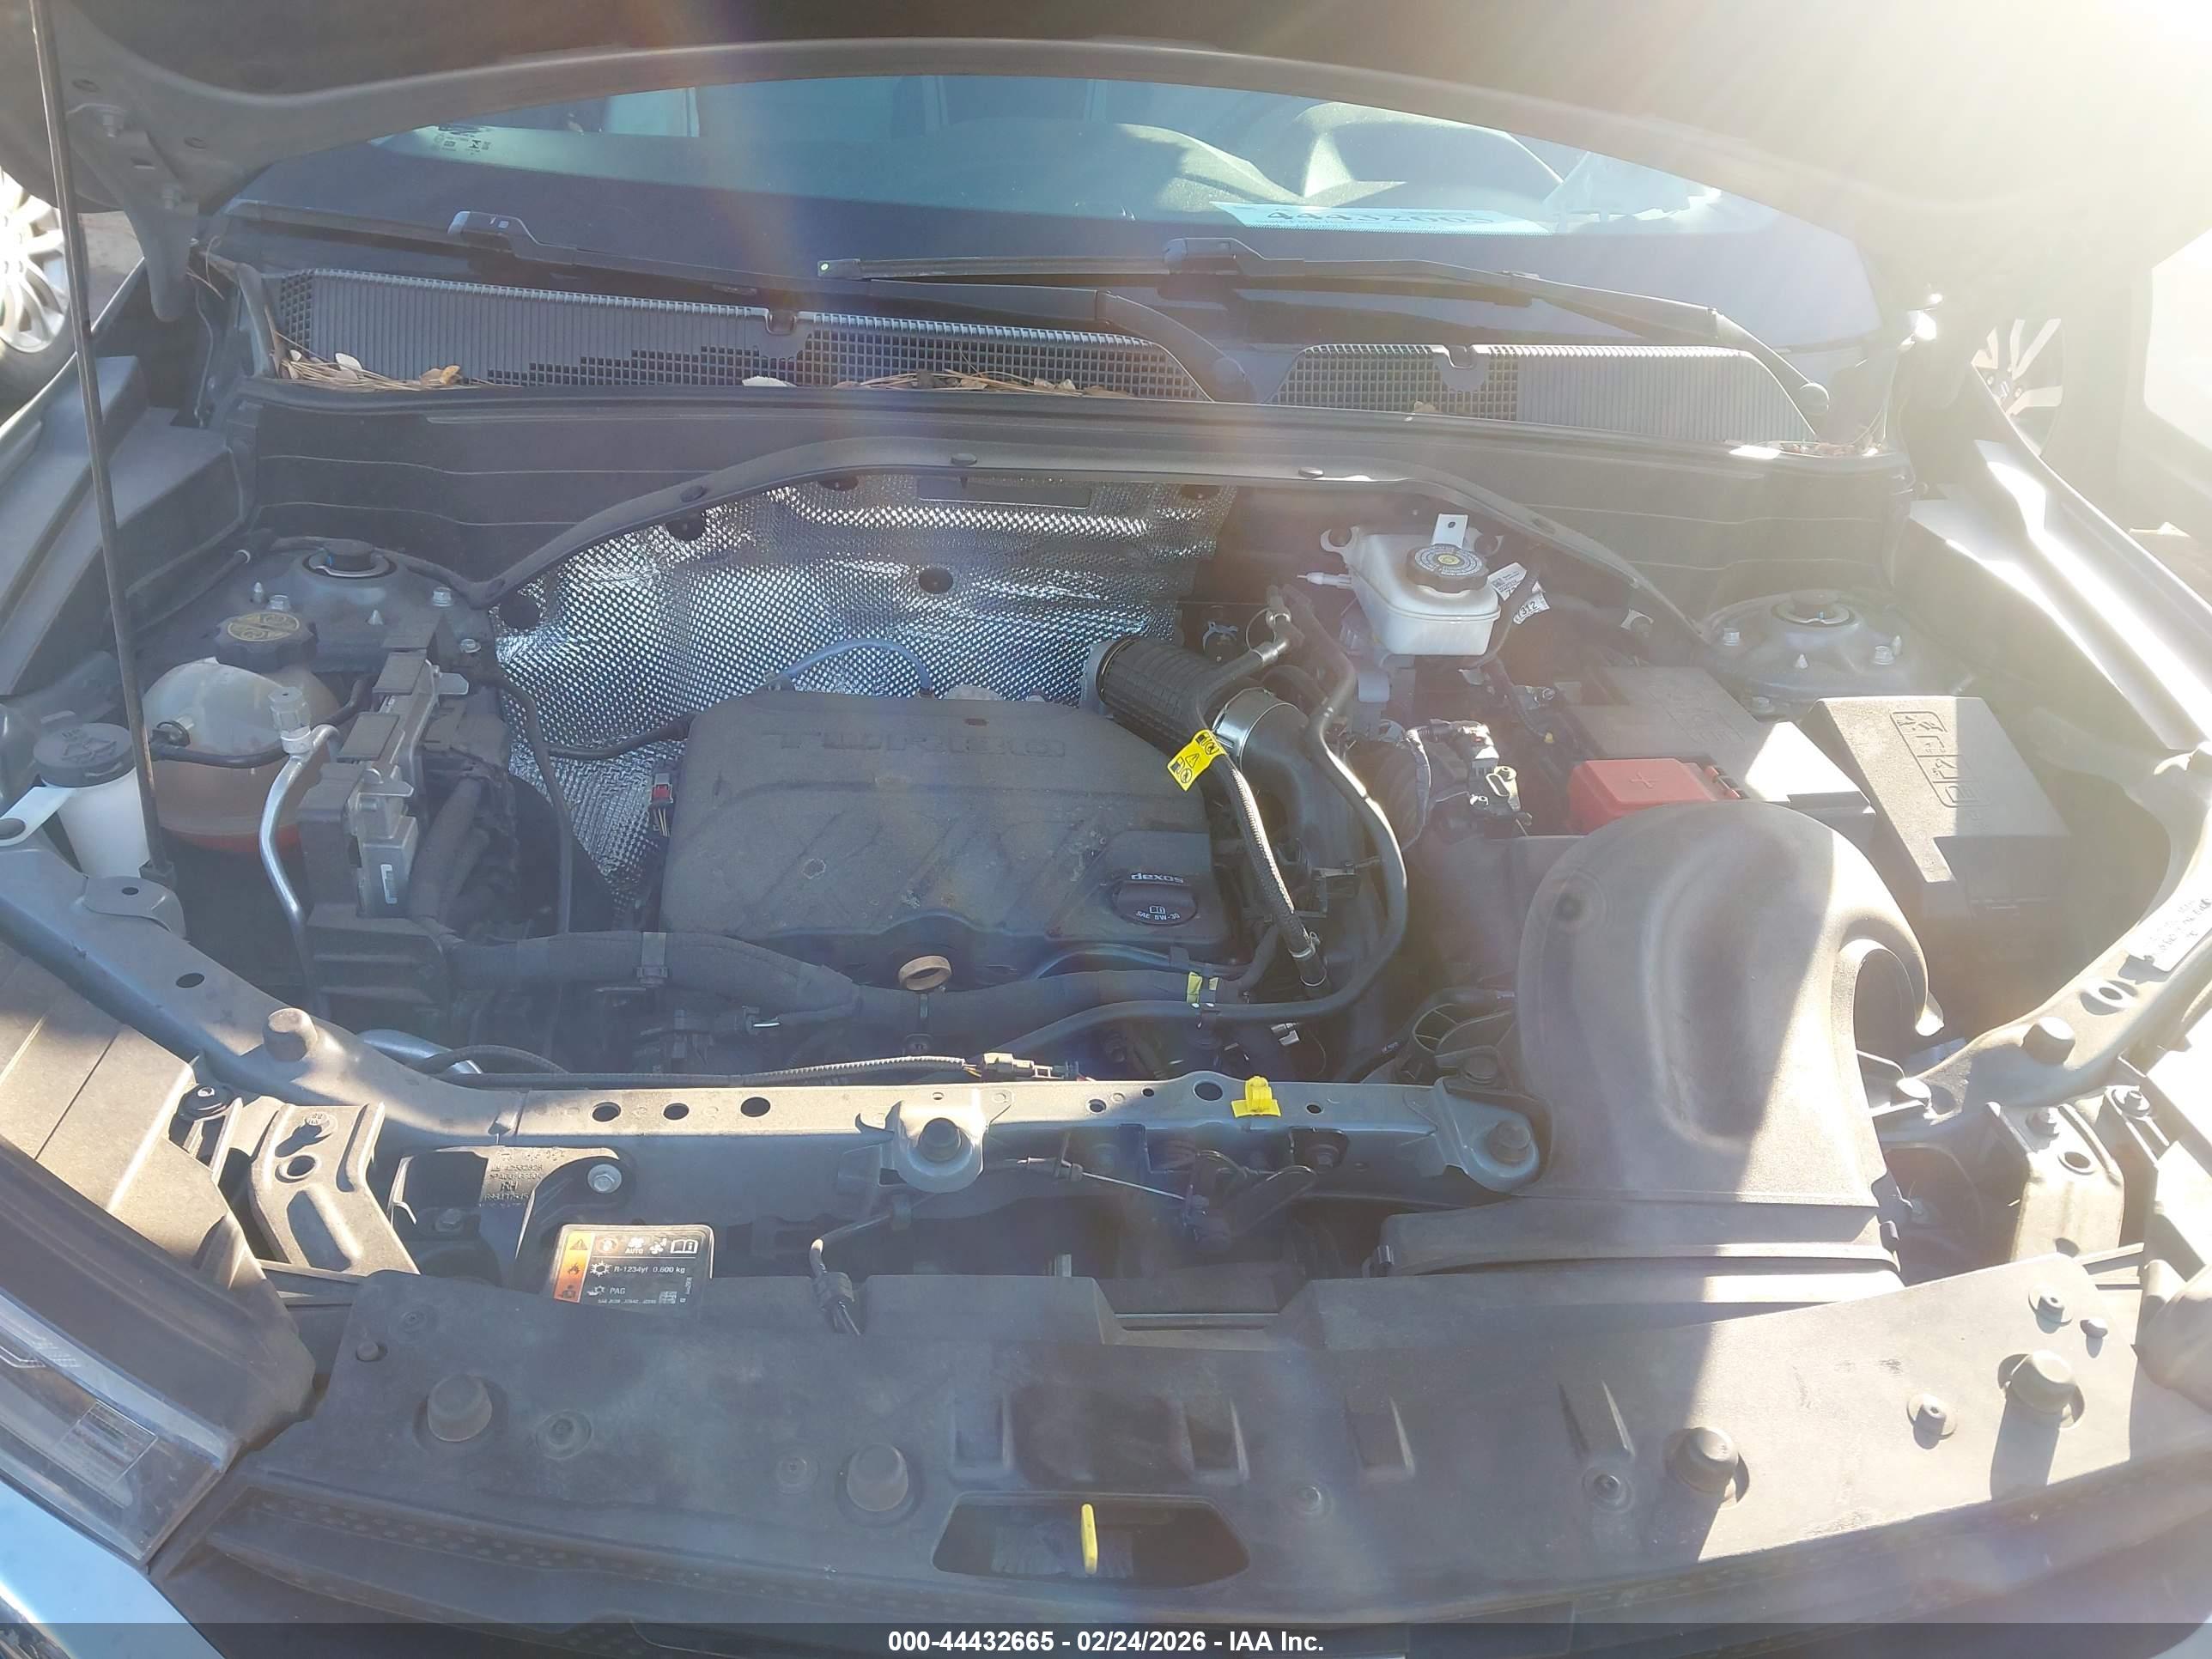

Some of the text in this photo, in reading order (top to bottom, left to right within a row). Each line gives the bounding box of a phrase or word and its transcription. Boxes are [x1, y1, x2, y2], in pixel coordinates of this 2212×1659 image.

[1131, 872, 1184, 884] dexos
[1135, 910, 1181, 921] SAE 5W-30
[614, 1266, 648, 1274] R-1234yf
[676, 1266, 686, 1274] kg
